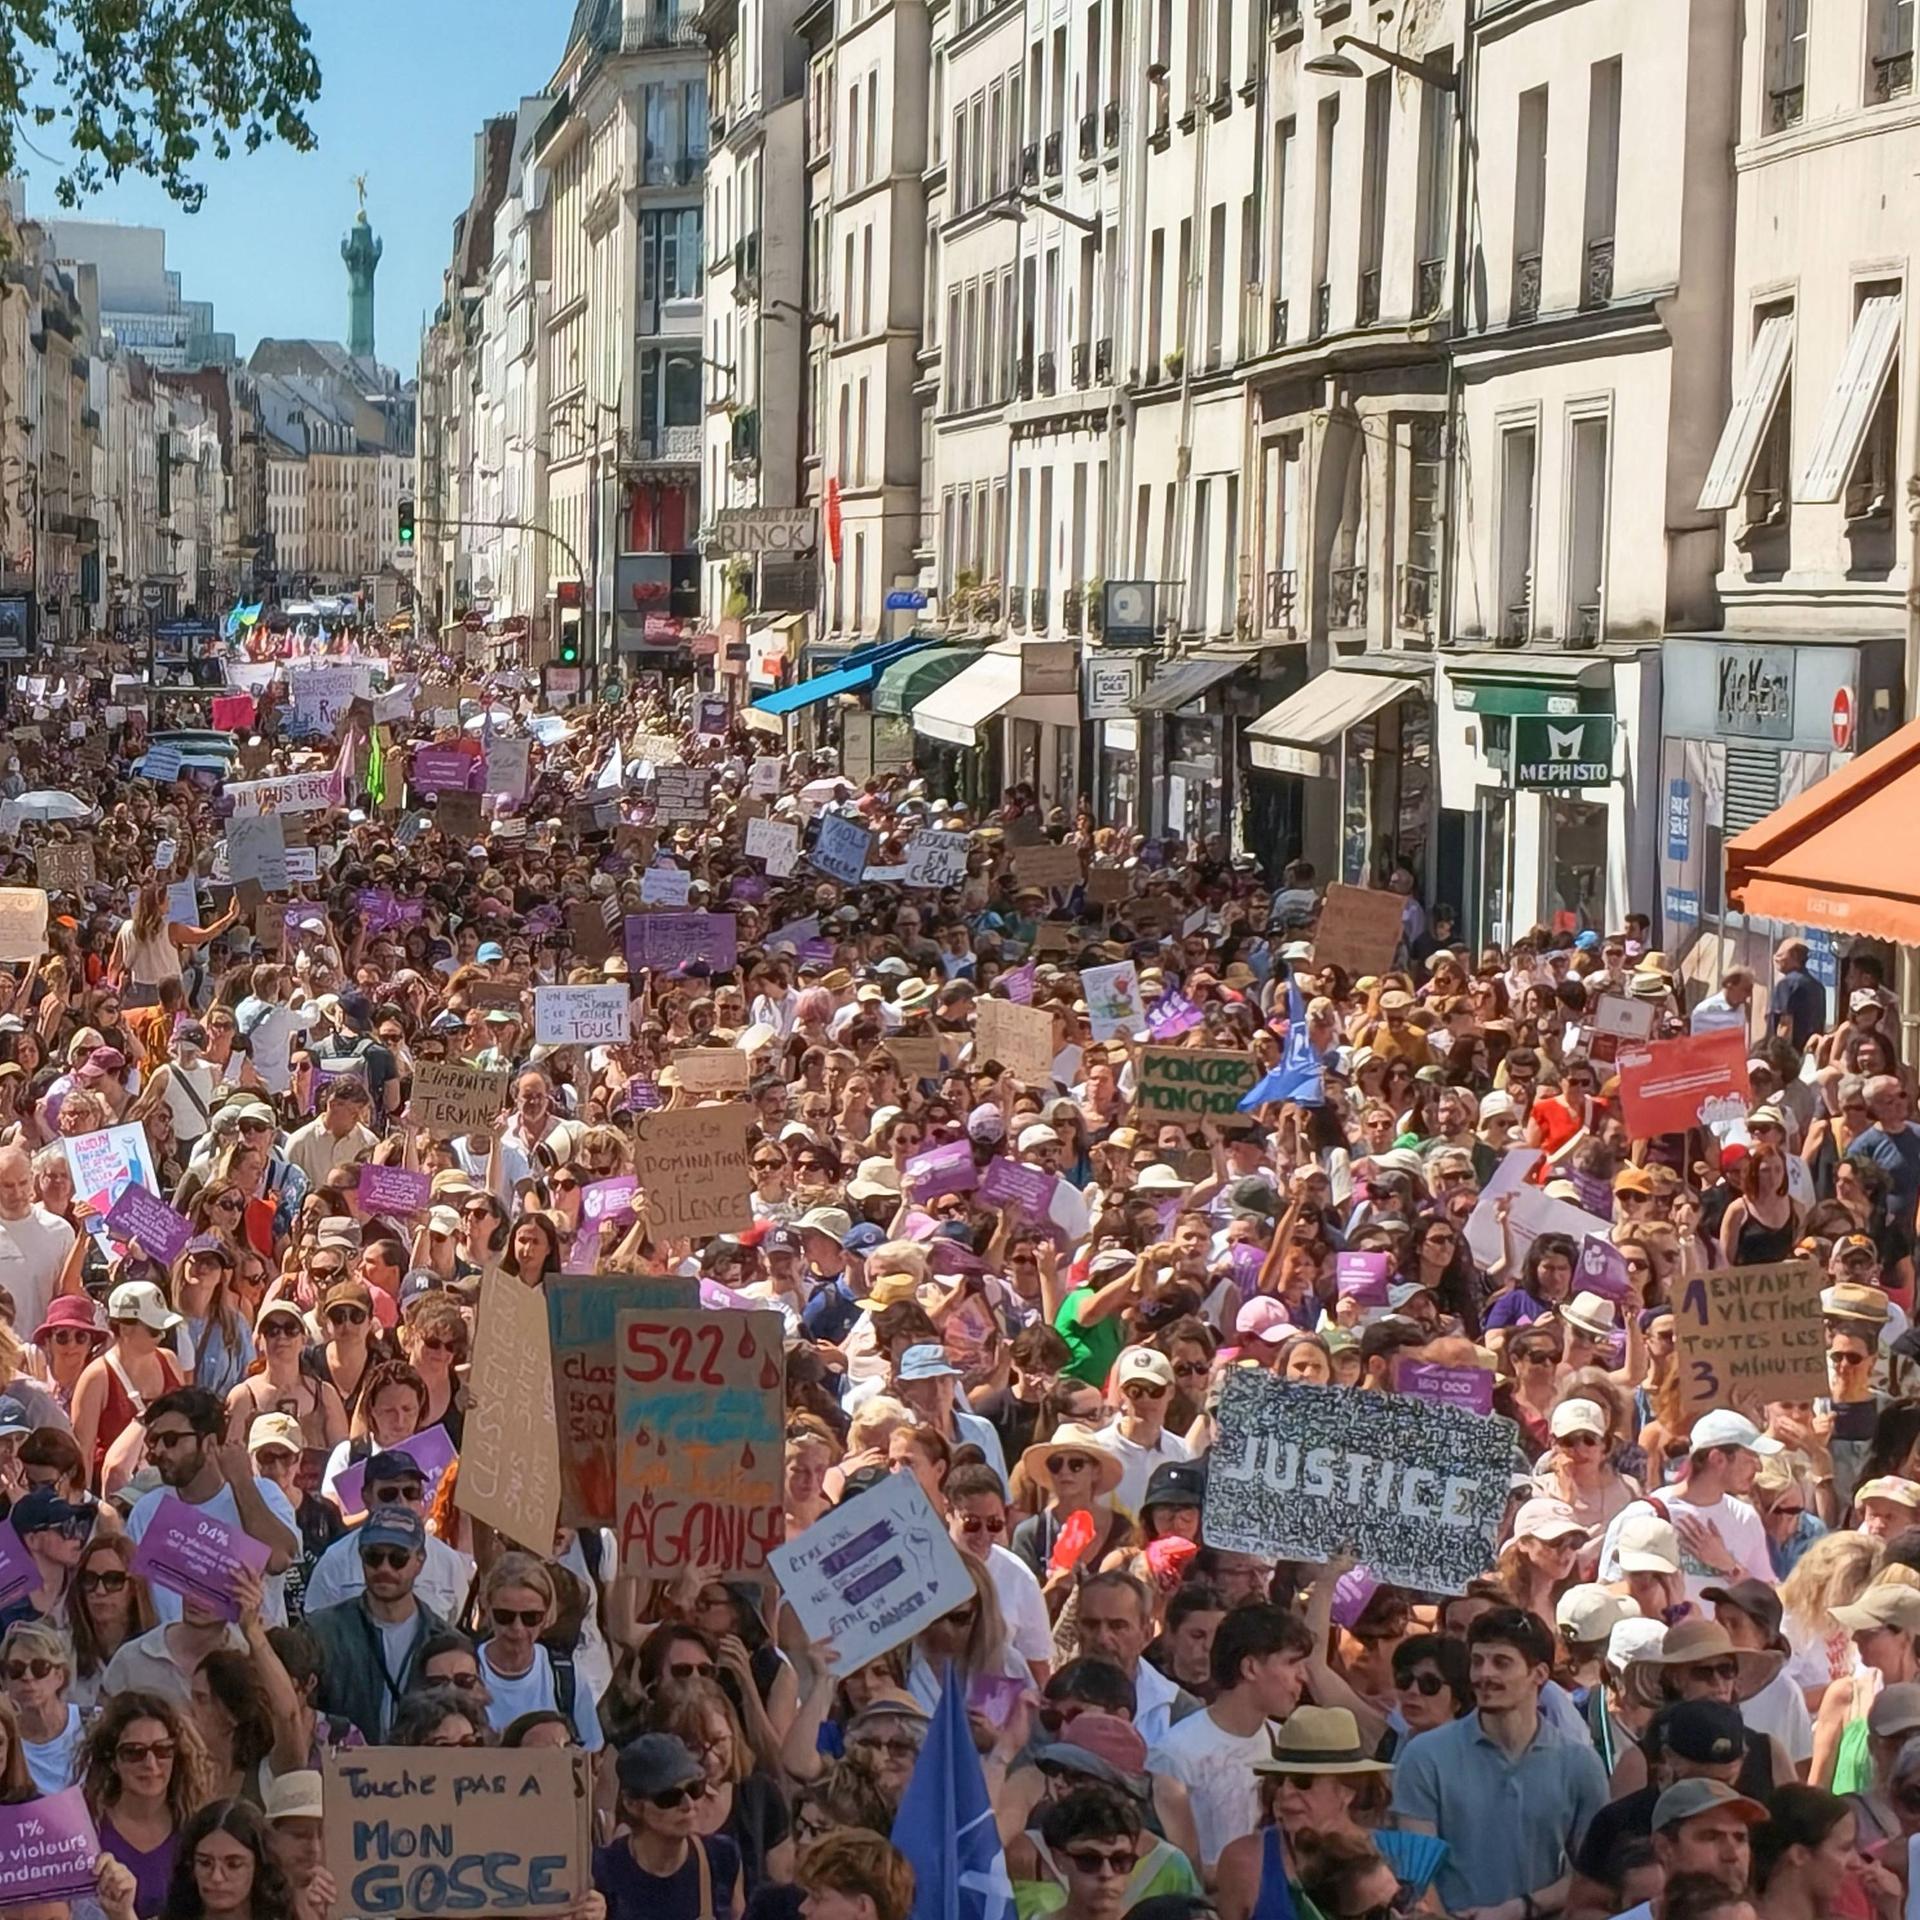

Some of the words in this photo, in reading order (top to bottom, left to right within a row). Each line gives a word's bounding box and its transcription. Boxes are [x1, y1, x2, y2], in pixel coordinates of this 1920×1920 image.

[721, 524, 807, 548] RINCK
[1520, 763, 1608, 781] MEPHISTO
[1139, 1082, 1186, 1109] MON
[644, 1148, 747, 1174] DOMINATION
[1682, 1279, 1708, 1326] 1
[1710, 1271, 1808, 1297] ENFANT
[1718, 1295, 1825, 1322] VICTIME
[624, 1322, 725, 1386] 522
[1682, 1331, 1770, 1353] TOUTES
[1781, 1329, 1819, 1347] LES
[1691, 1361, 1719, 1401] 3
[1729, 1354, 1824, 1377] MINUTES
[1221, 1433, 1482, 1526] JUSTICE
[339, 1766, 437, 1799] Touche
[17, 1819, 45, 1839] 1%
[353, 1819, 453, 1862] MON
[351, 1851, 571, 1914] GOSSE
